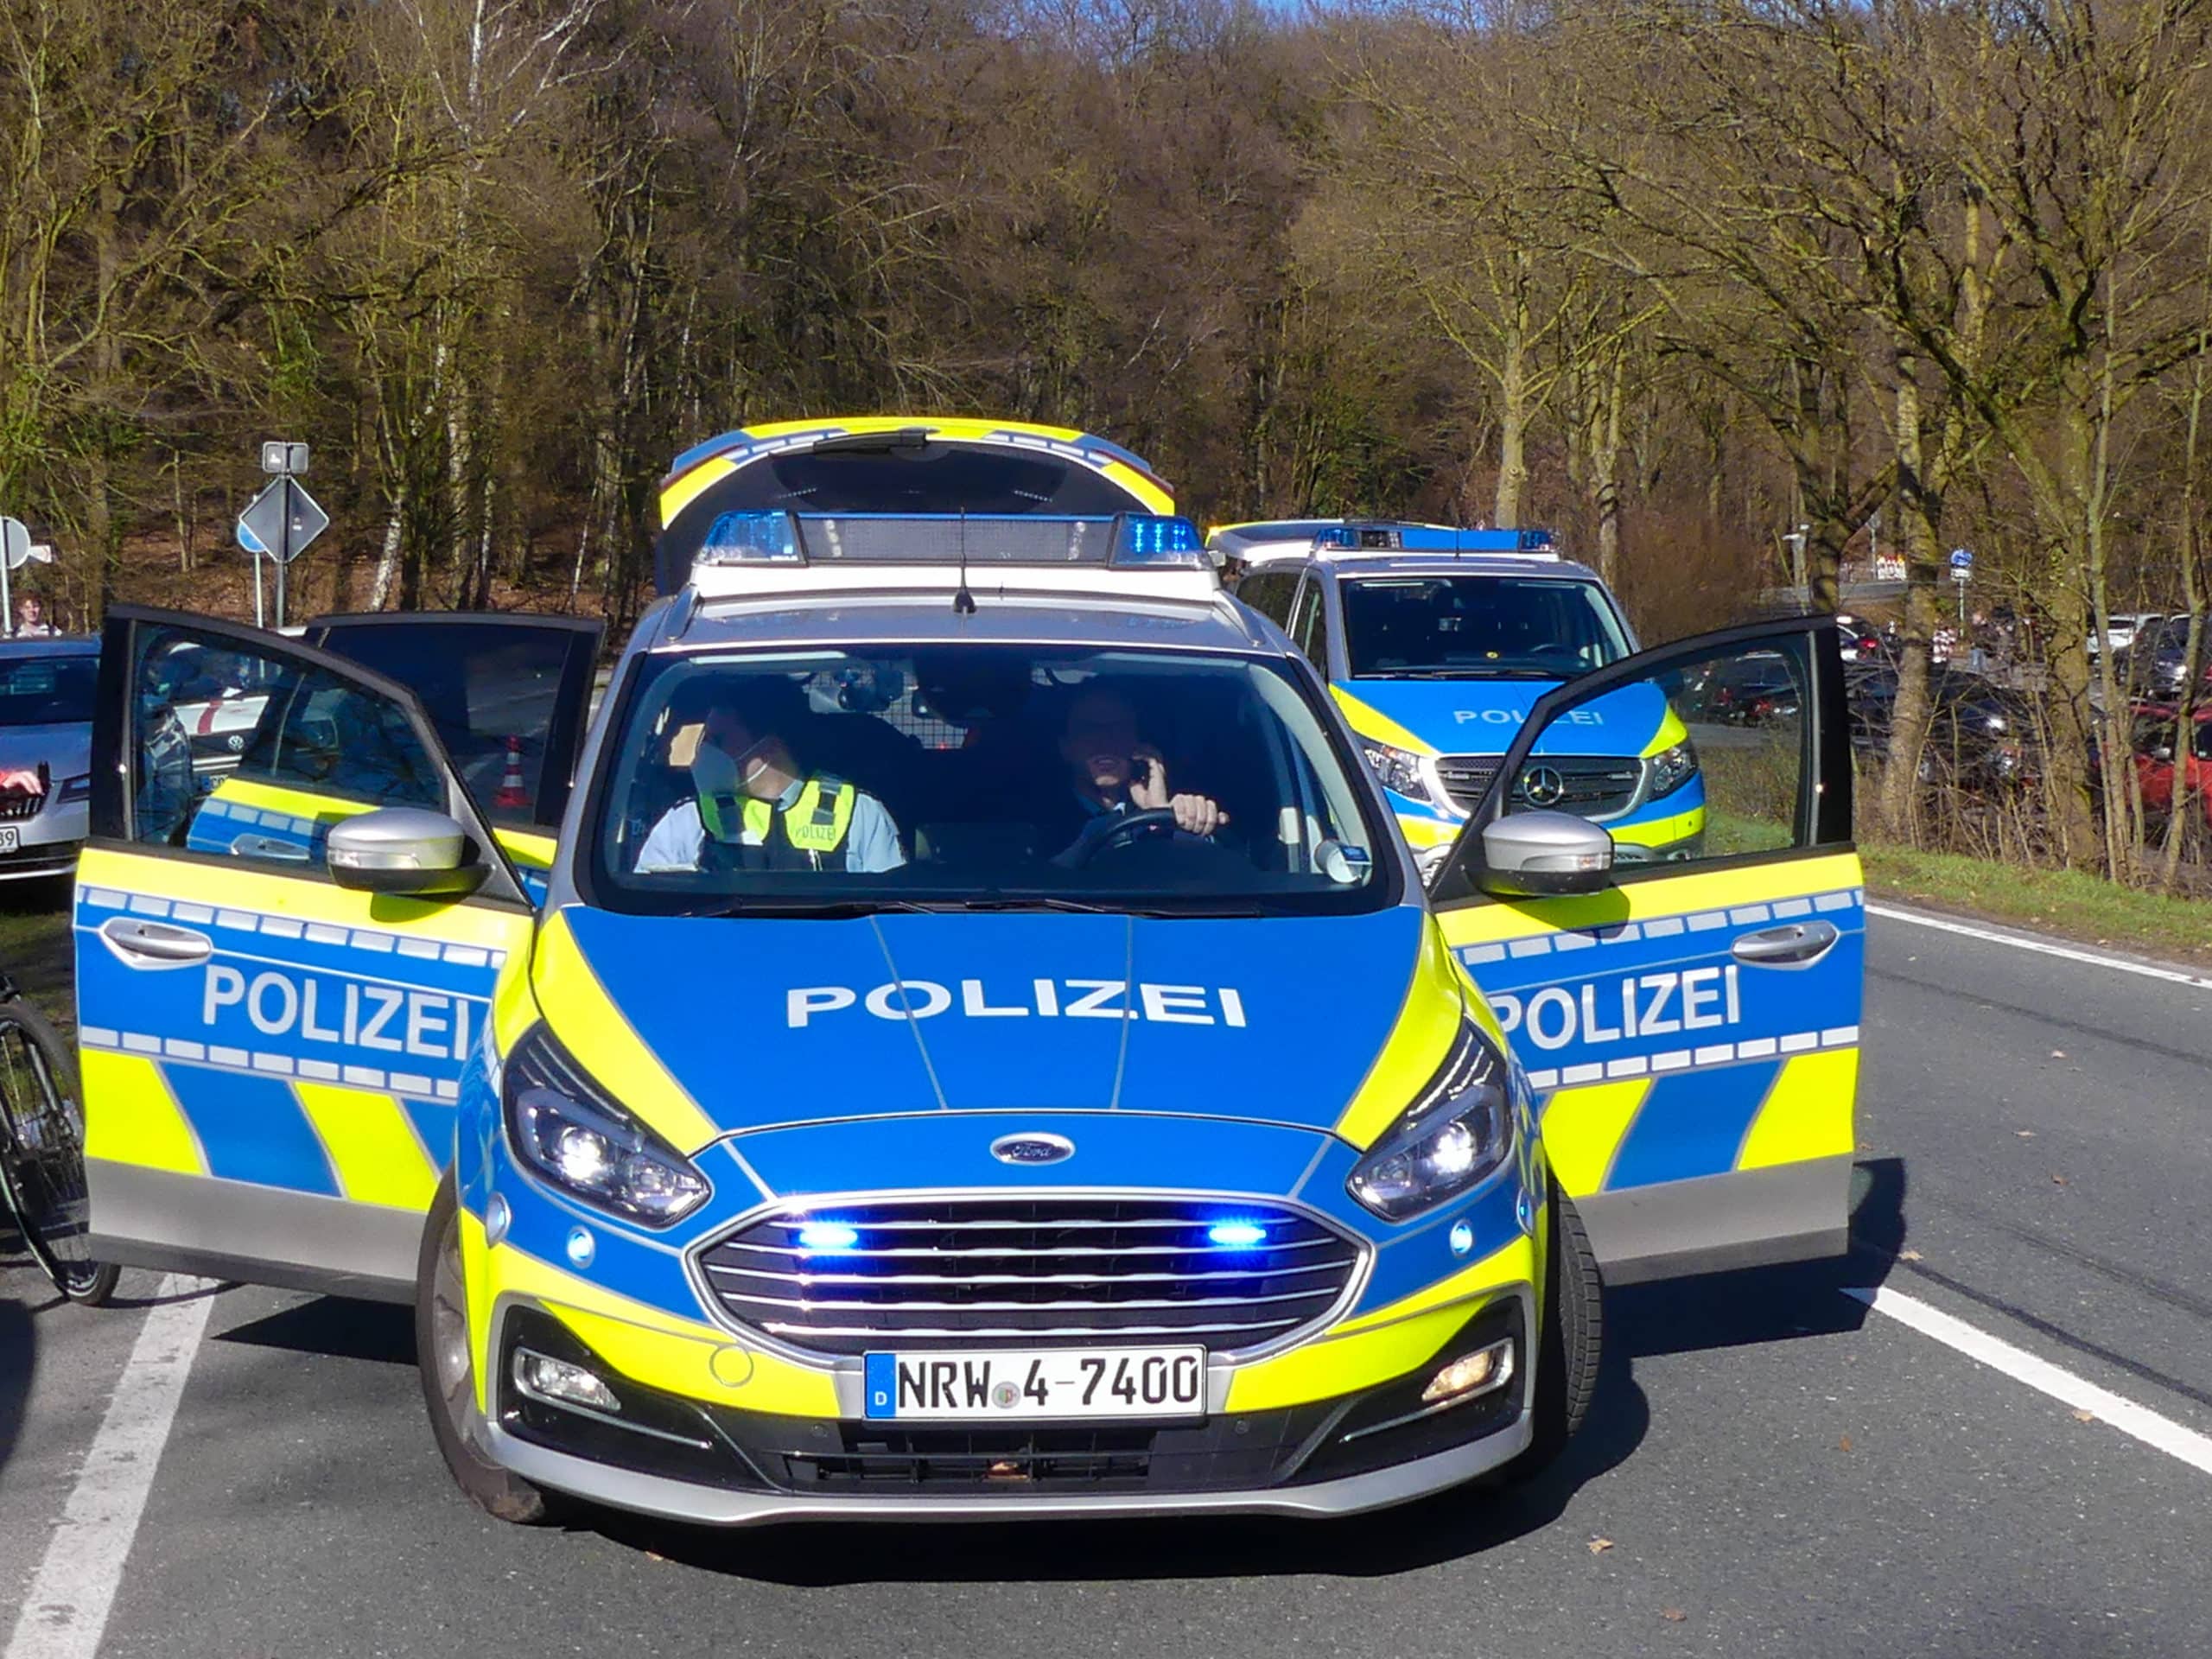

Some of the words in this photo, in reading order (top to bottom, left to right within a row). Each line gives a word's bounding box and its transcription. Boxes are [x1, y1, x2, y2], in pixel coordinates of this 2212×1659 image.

[203, 963, 469, 1061] POLIZEI
[787, 979, 1247, 1028] POLIZEI
[874, 1391, 887, 1406] D
[899, 1360, 991, 1408] NRW
